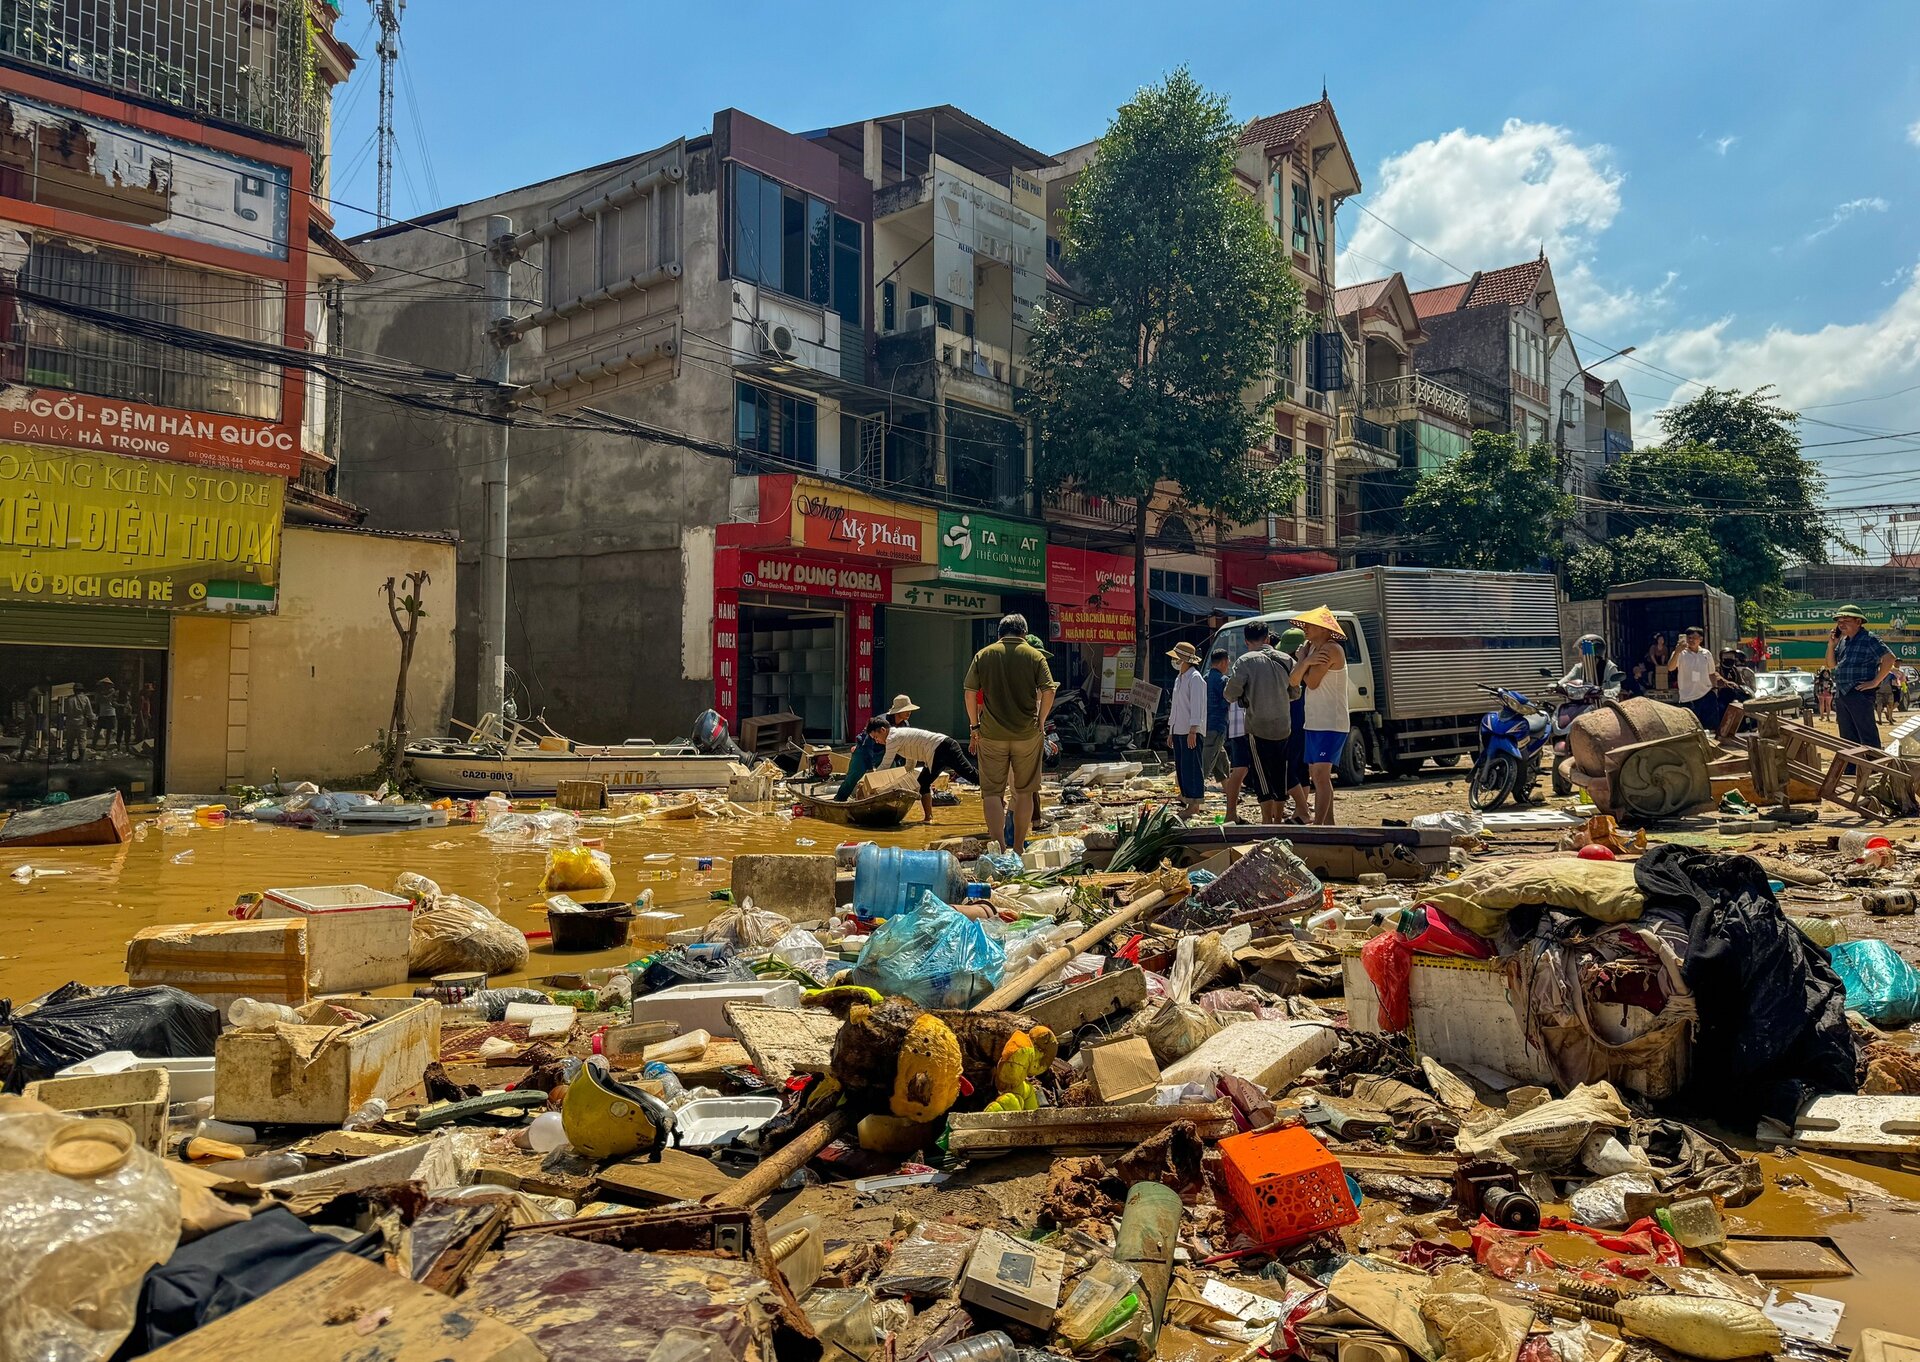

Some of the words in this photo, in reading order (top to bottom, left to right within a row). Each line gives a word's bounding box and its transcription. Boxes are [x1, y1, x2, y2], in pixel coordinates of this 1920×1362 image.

[13, 421, 45, 439] ĐẠI
[78, 428, 104, 445] HÀ
[110, 434, 170, 454] TRỌNG
[160, 412, 214, 440] HÀN
[221, 424, 294, 450] QUỐC
[103, 463, 175, 497] KIÊN
[185, 475, 271, 508] STORE
[797, 494, 849, 542] Shop
[80, 500, 169, 566] ĐIỆN
[179, 514, 277, 574] THOẠI
[841, 517, 868, 552] Mỹ
[871, 522, 918, 552] Phẩm
[992, 550, 1009, 563] GIỚI
[10, 570, 44, 594] VÔ
[52, 574, 101, 600] ĐỊCH
[108, 575, 142, 600] GIÁ
[148, 575, 174, 601] RẺ
[744, 574, 753, 584] 1A
[758, 561, 792, 581] HUY
[794, 565, 837, 587] DUNG
[838, 570, 882, 592] KOREA
[718, 601, 736, 620] HÀNG
[717, 632, 736, 649] KOREA
[721, 690, 732, 709] ĐỊA
